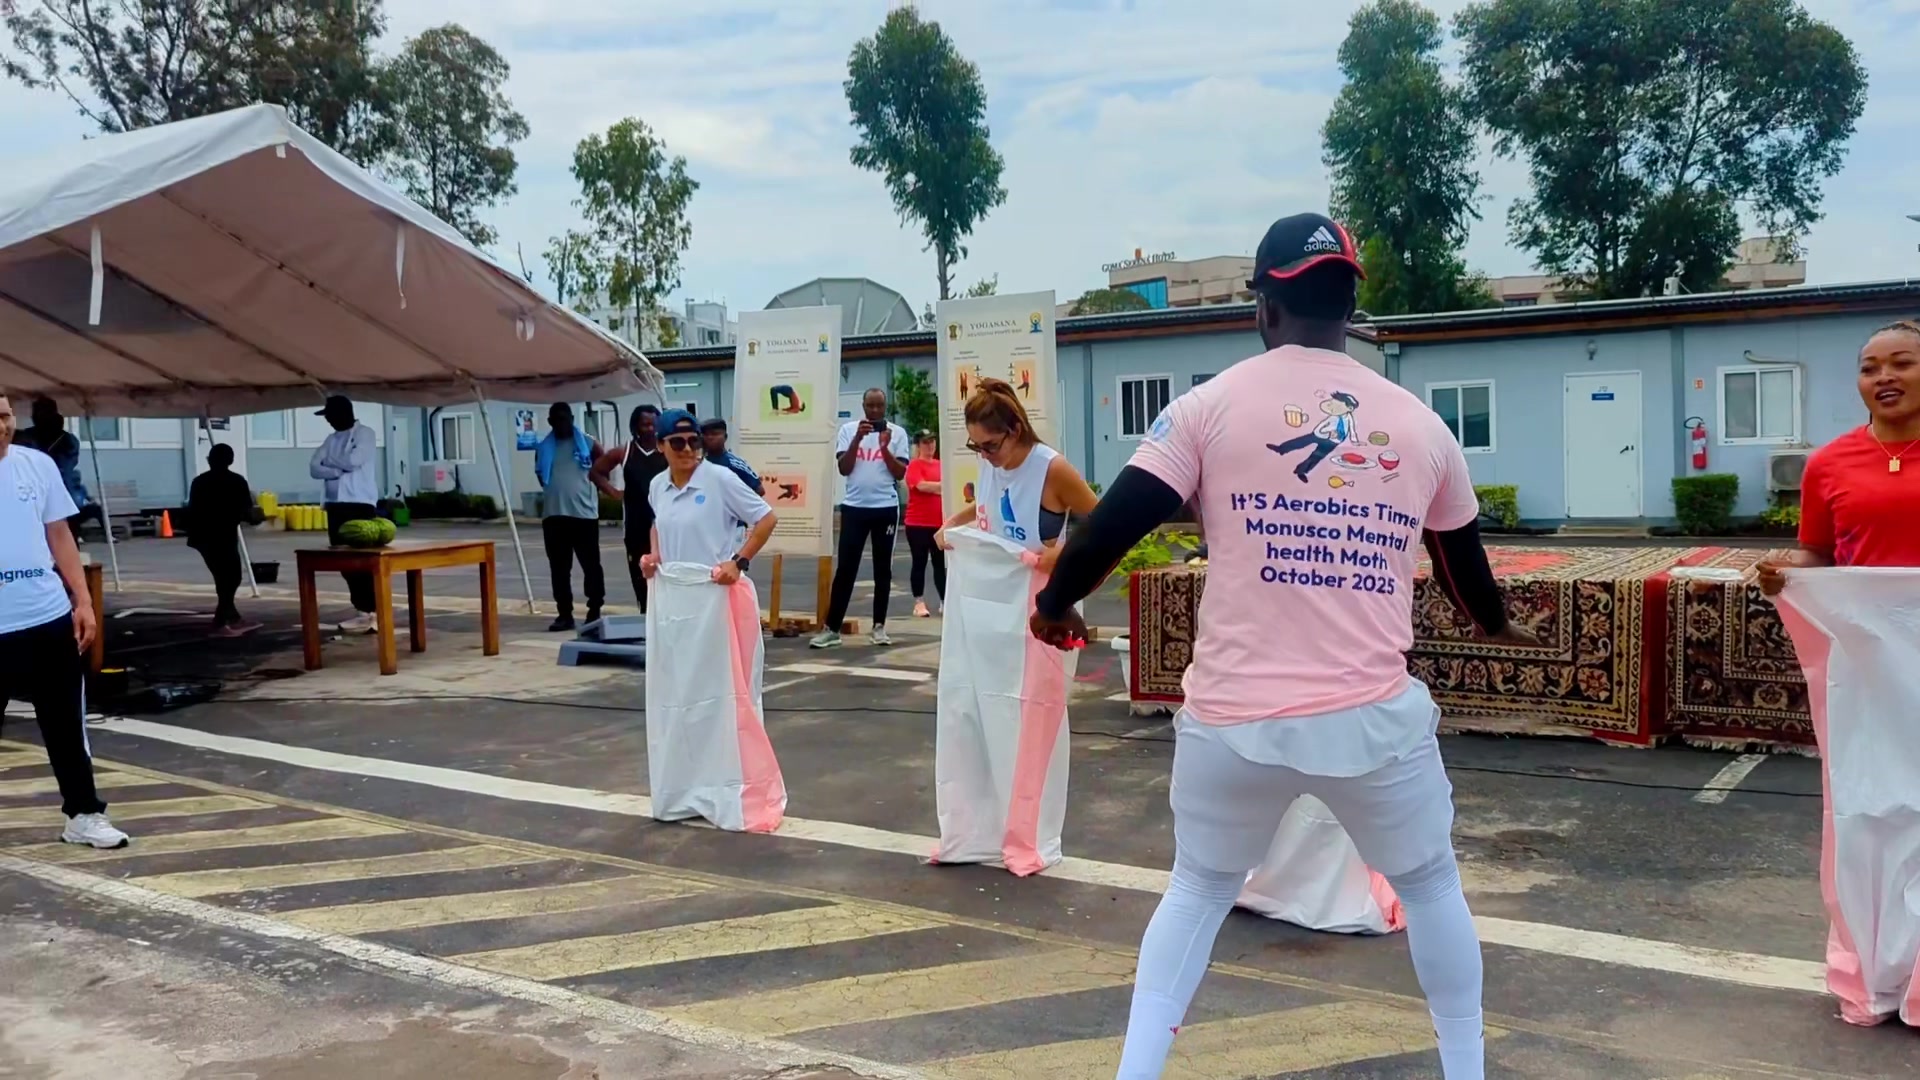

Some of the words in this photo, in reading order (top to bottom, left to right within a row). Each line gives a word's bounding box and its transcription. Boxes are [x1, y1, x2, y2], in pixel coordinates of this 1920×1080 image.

[1303, 239, 1341, 252] adidas
[1272, 493, 1370, 518] Aerobics
[1246, 518, 1341, 540] Monusco
[1346, 524, 1409, 552] Mental
[1266, 541, 1334, 564] health
[1340, 548, 1388, 570] Moth
[1260, 566, 1347, 589] October
[1351, 573, 1395, 595] 2025
